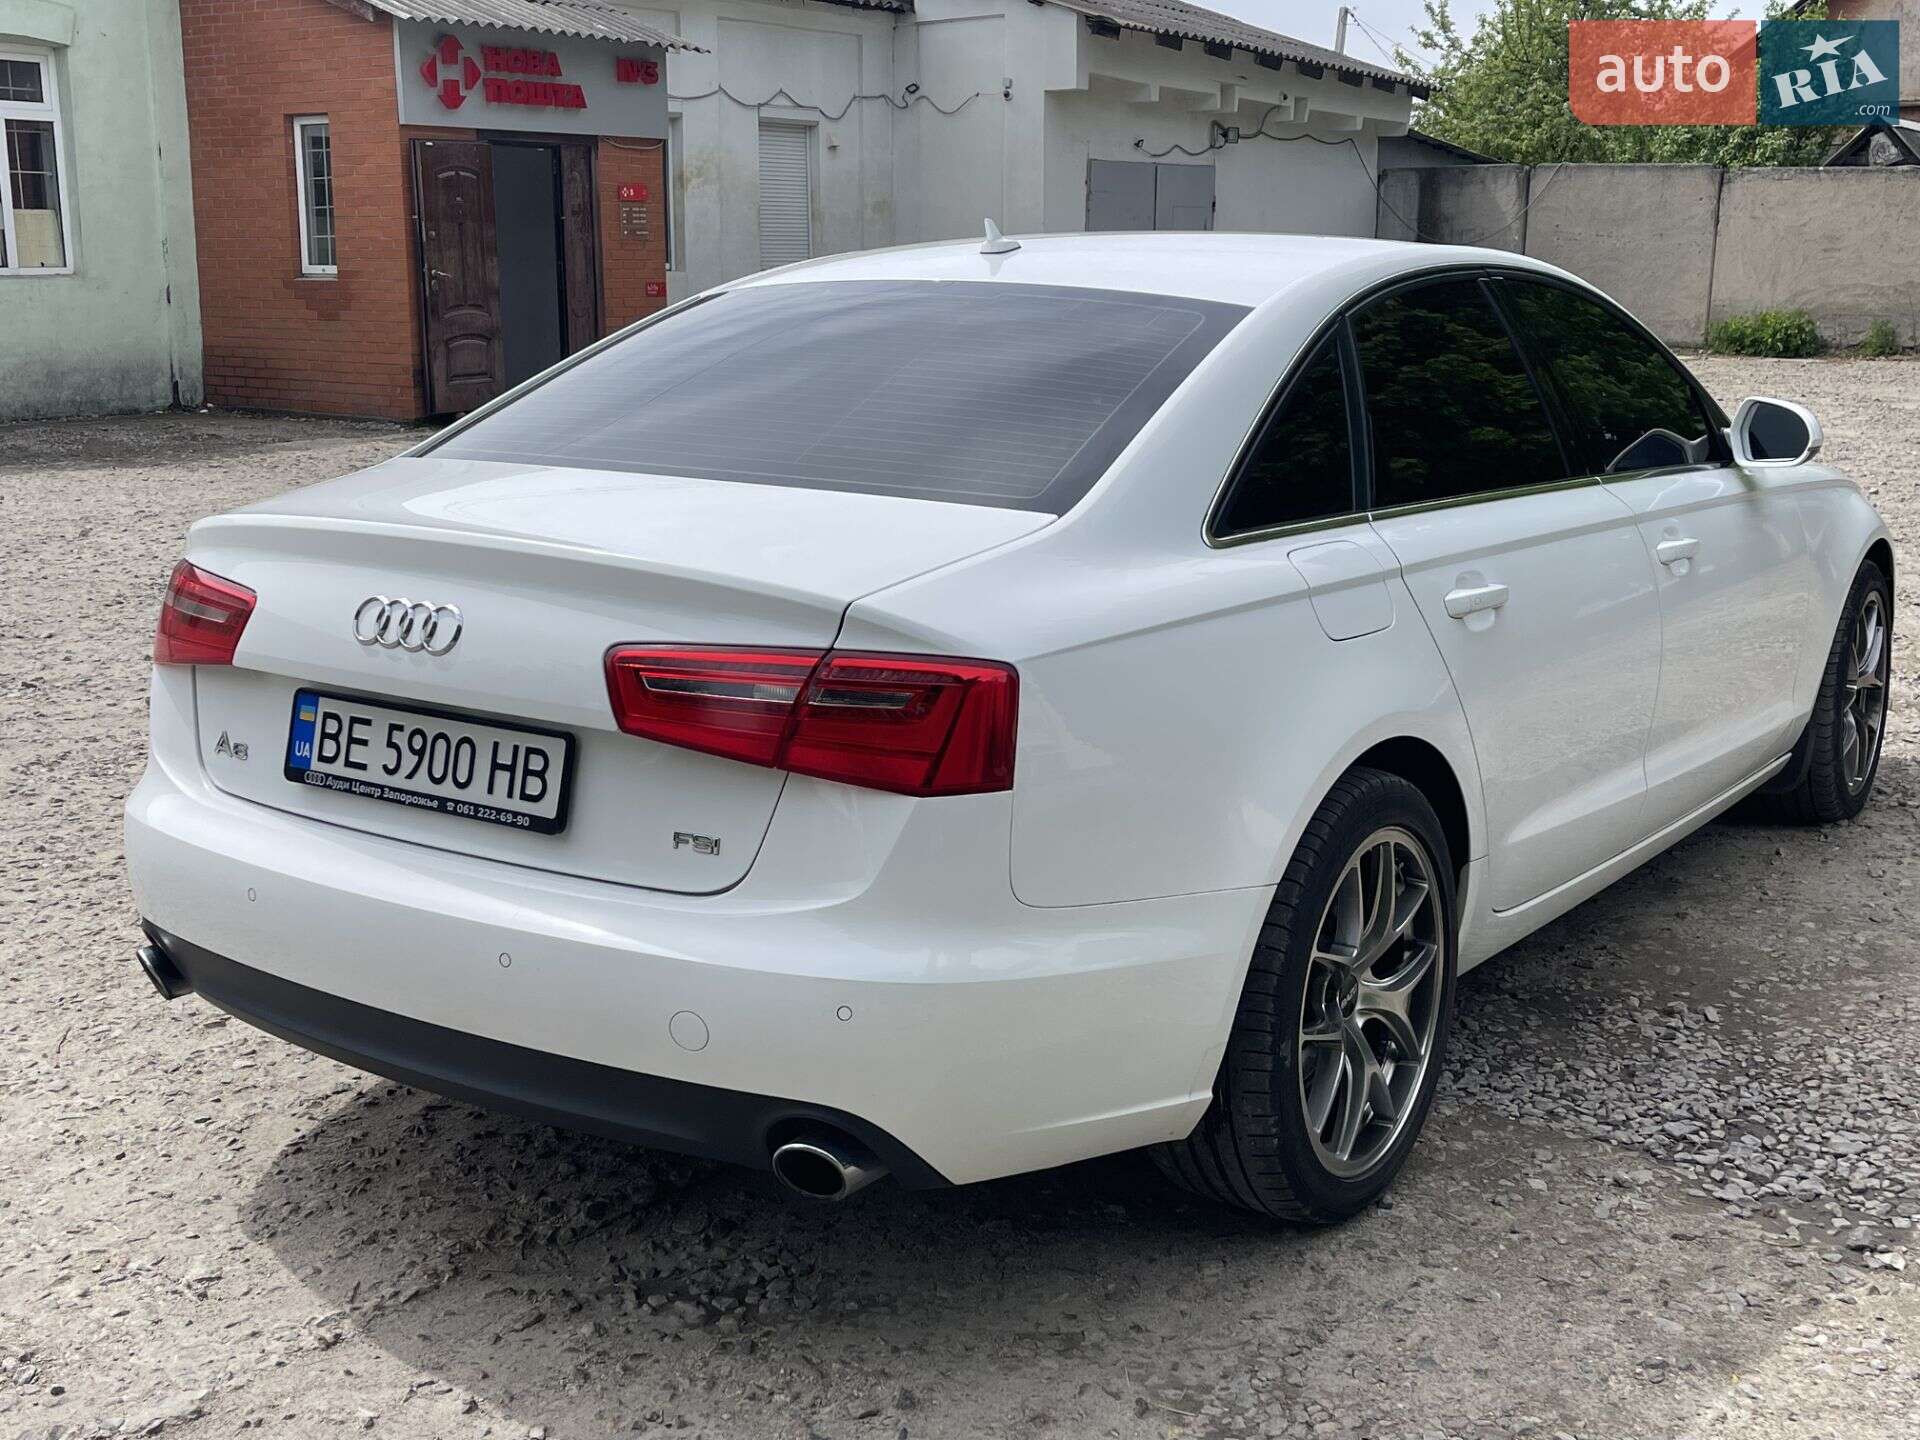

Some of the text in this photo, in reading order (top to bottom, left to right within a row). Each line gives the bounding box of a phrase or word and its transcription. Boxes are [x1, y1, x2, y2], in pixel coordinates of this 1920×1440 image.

[481, 45, 563, 77] НОВА
[483, 78, 588, 109] ПОШТА
[295, 740, 311, 759] UA
[316, 710, 550, 803] BE 5900 HB
[326, 777, 530, 827] Ауди Центр Запорожье 061 222-69-90
[673, 831, 721, 857] FSI
